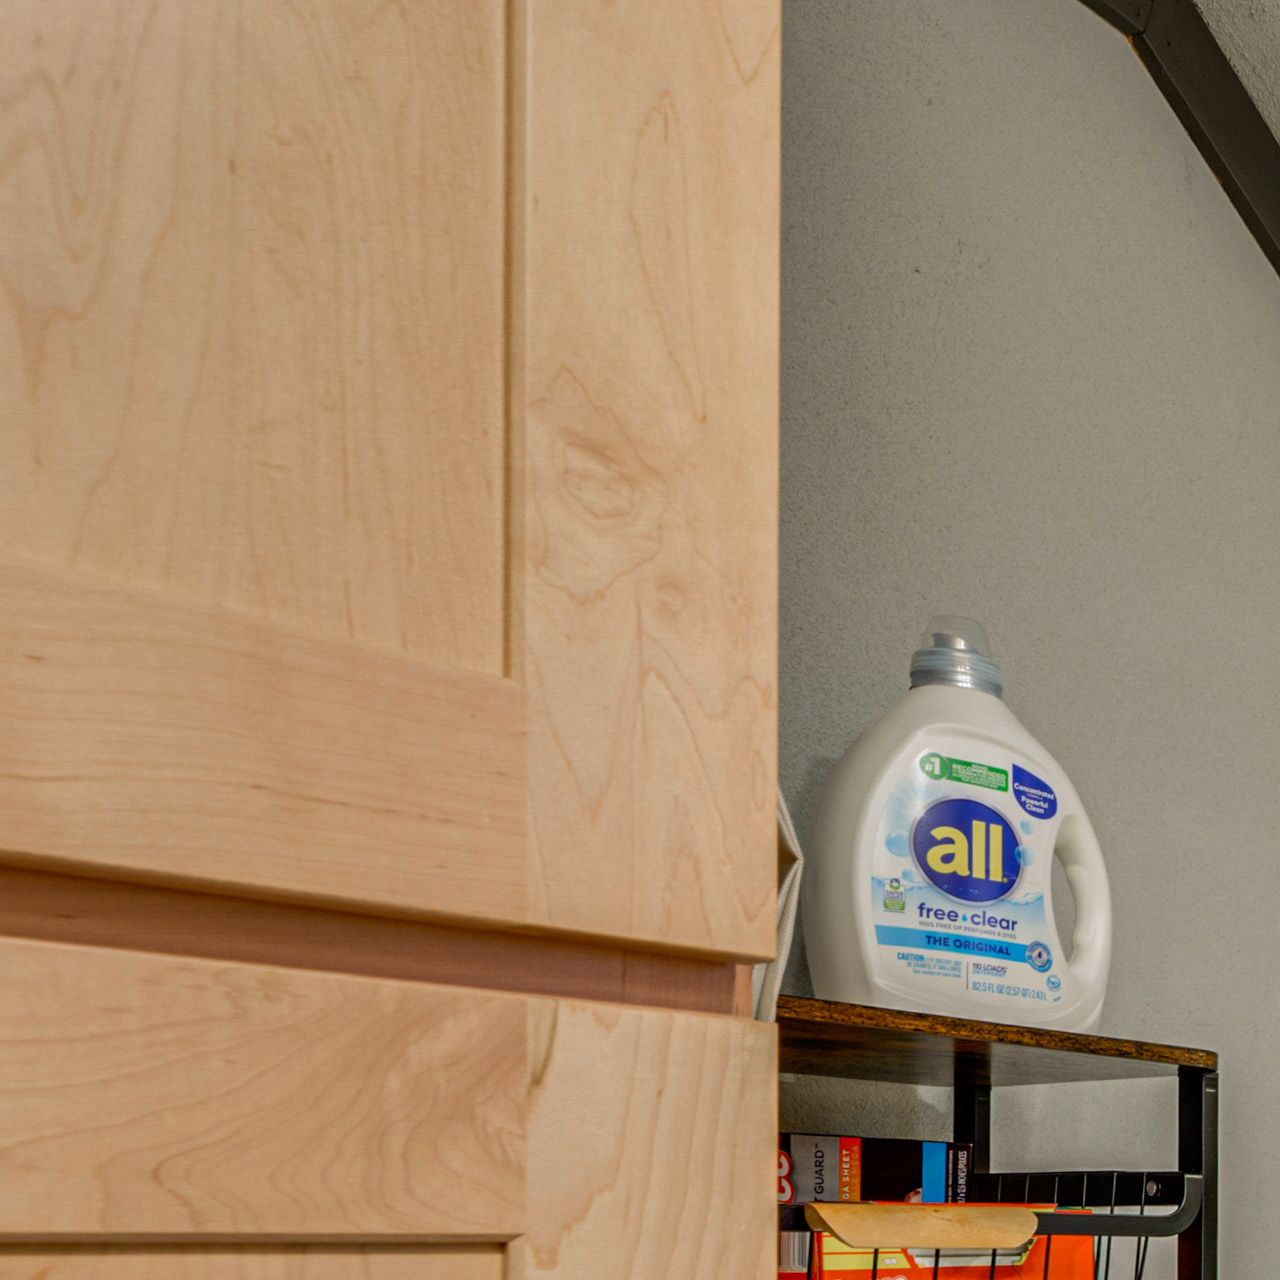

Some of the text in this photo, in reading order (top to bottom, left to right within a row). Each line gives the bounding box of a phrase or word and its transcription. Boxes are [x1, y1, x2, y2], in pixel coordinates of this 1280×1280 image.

[926, 820, 1003, 882] all
[917, 902, 1018, 931] free clear
[925, 935, 1011, 956] THE ORIGINAL
